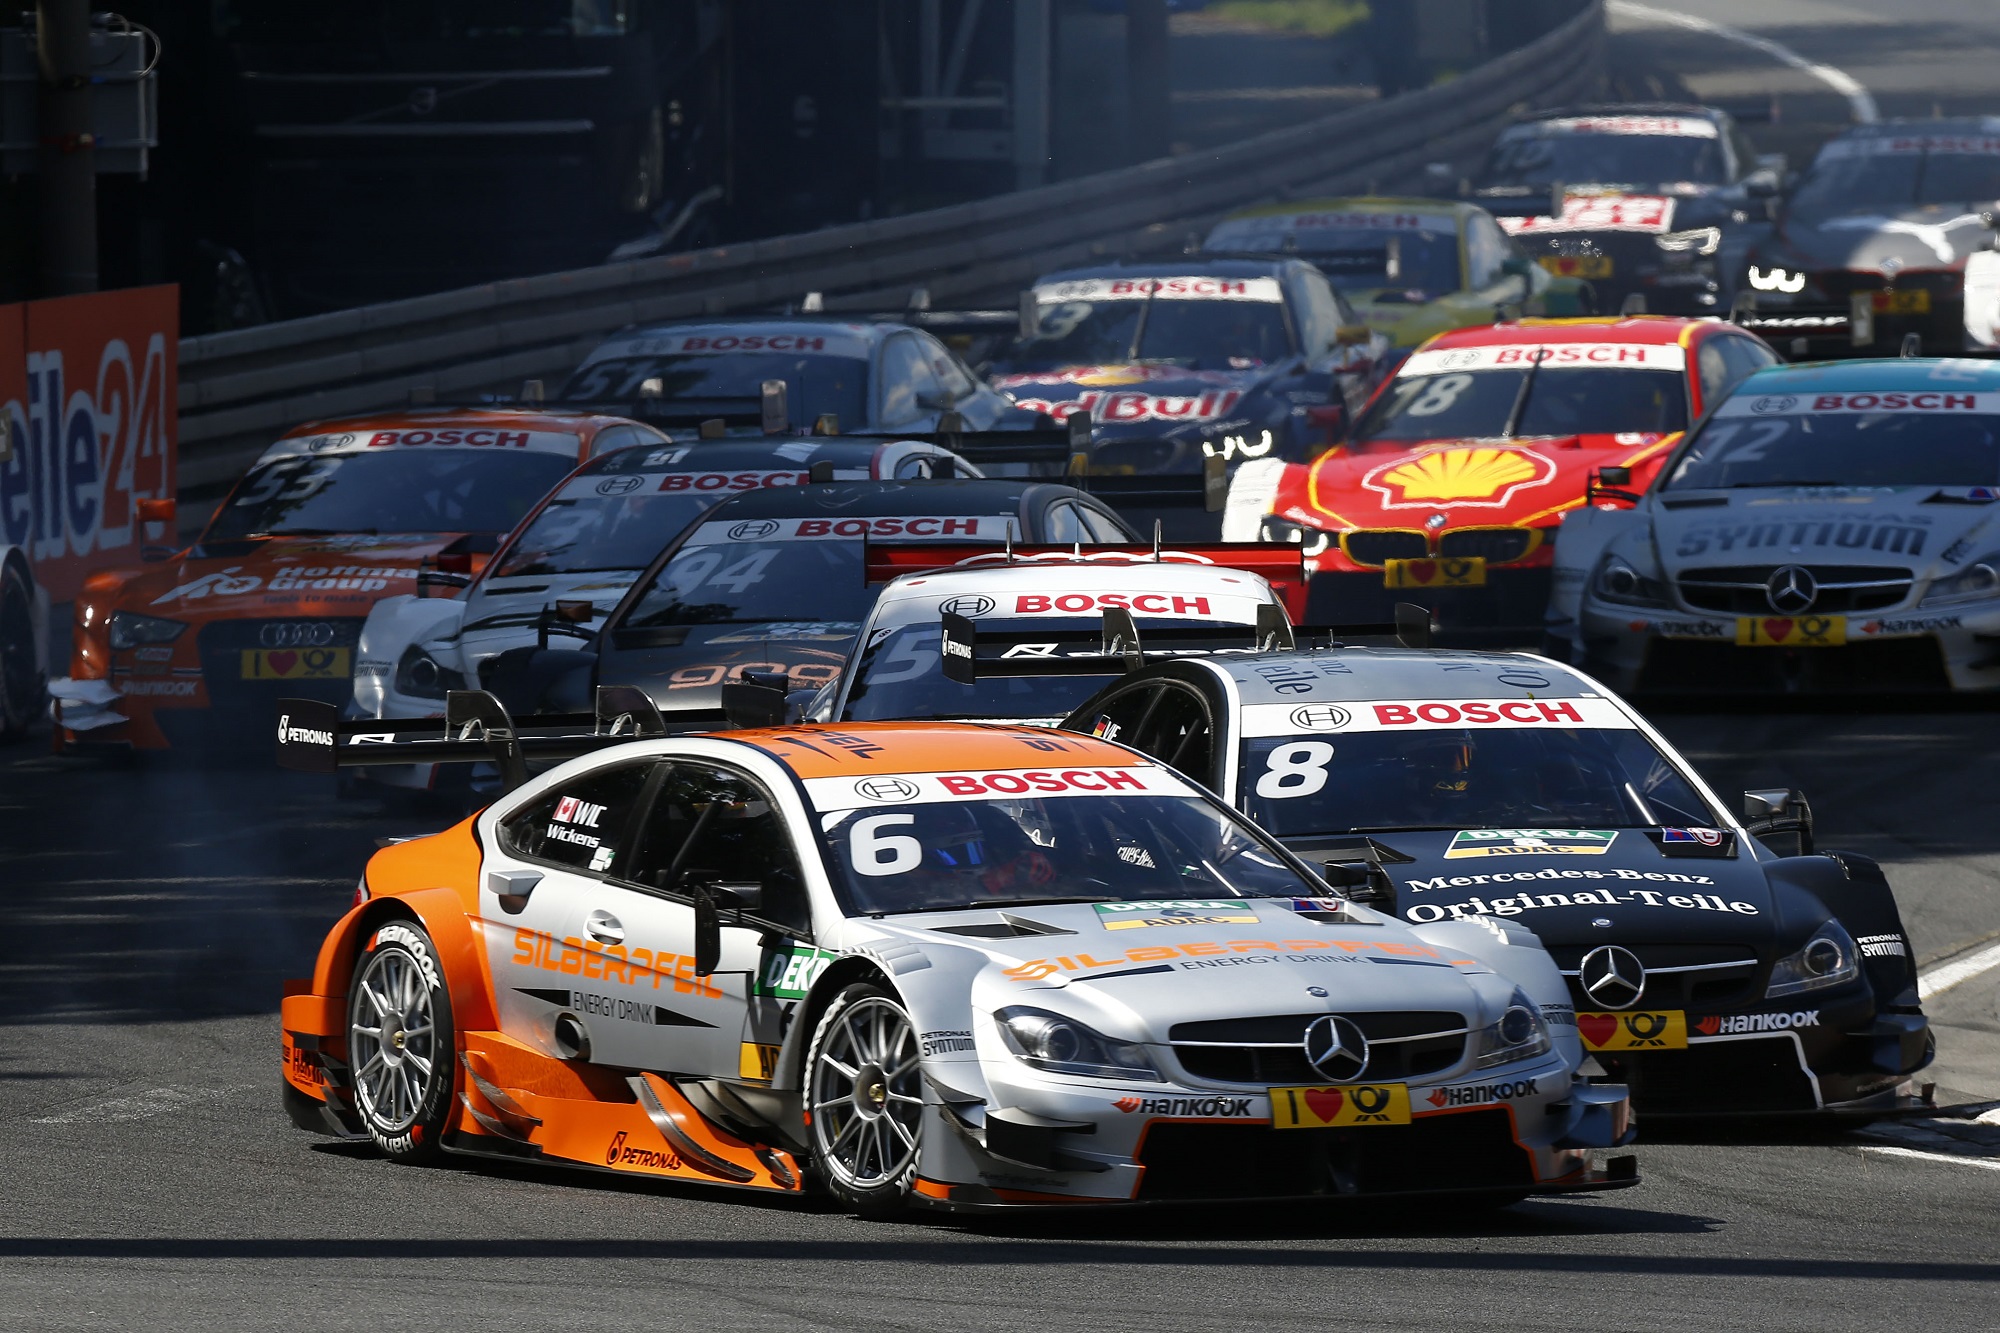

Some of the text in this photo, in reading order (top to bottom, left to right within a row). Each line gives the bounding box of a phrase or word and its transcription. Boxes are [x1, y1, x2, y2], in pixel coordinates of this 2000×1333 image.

[1110, 280, 1246, 295] BOSCH
[683, 336, 824, 351] BOSCH
[1495, 344, 1646, 363] BOSCH
[1394, 374, 1474, 418] 18
[1812, 394, 1976, 411] BOSCH
[1103, 390, 1244, 425] Bull
[368, 430, 530, 448] BOSCH
[235, 458, 344, 506] 53
[658, 472, 811, 492] BOSC
[795, 517, 978, 538] BOSCH
[275, 565, 420, 579] Hoffma
[267, 577, 388, 592] Group
[1015, 594, 1212, 615] BOSCH
[948, 640, 972, 659] PETRONAS
[1372, 702, 1585, 726] BOSCH
[288, 728, 334, 746] PETRONAS
[1255, 741, 1335, 799] 8
[936, 771, 1149, 796] BOSCH
[572, 801, 608, 828] WIC
[546, 824, 602, 849] Wickens
[849, 813, 923, 877] 6
[1476, 829, 1606, 841] DEKRA
[1486, 846, 1576, 855] ADAC
[1405, 868, 1715, 894] Mercedes-Benz
[1101, 901, 1243, 912] DEKRA
[1405, 886, 1760, 925] Original-Teile
[1142, 917, 1230, 926] ADAC
[1857, 933, 1903, 944] PETRONAS
[1181, 951, 1368, 971] ENERGY DRINK
[765, 953, 831, 991] DEKR
[574, 992, 654, 1025] ENERGY DRINK
[921, 1030, 972, 1040] PETRONAS
[923, 1039, 977, 1057] SYNTIUM
[1291, 1090, 1299, 1125] I
[622, 1147, 684, 1172] PETRONAS
